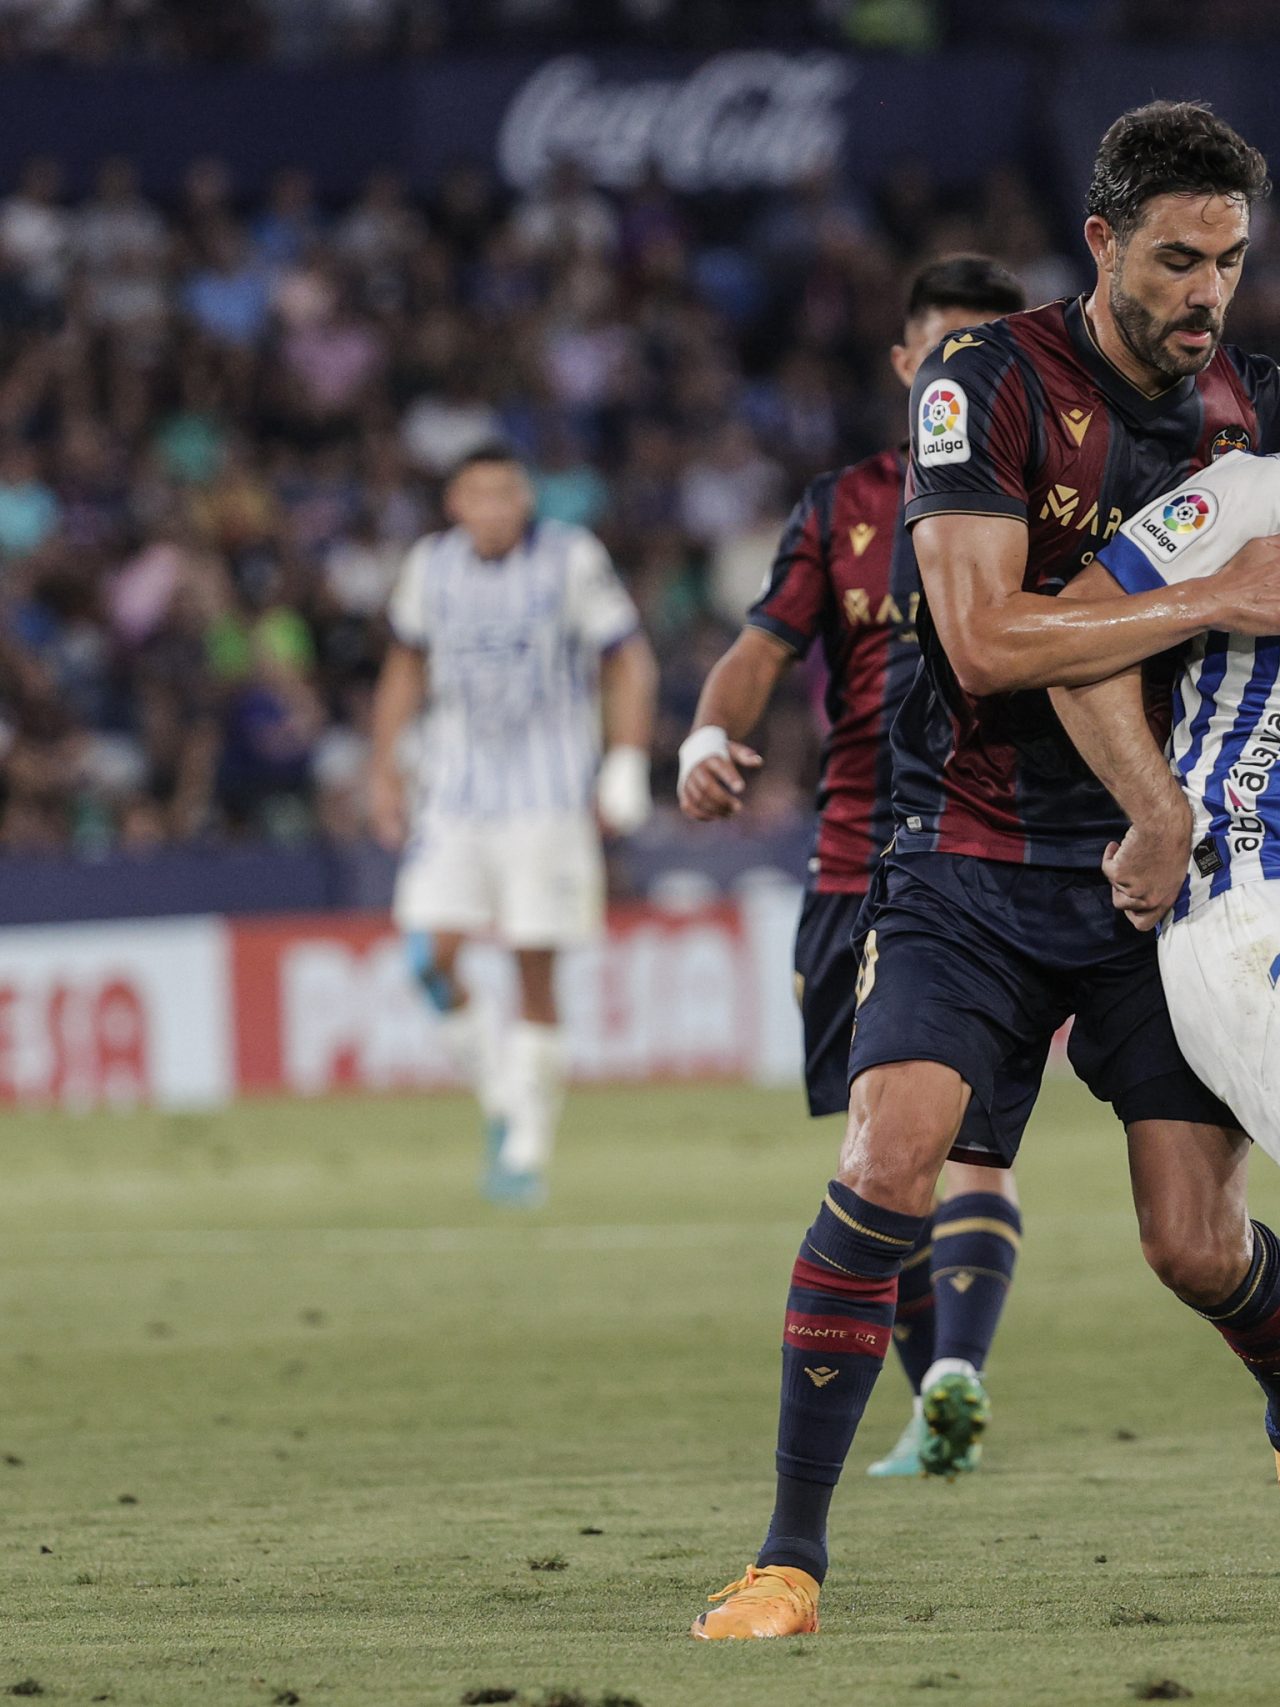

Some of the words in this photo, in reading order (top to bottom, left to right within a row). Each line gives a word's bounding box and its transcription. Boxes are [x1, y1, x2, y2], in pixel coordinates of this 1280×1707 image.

[923, 439, 964, 455] LaLiga
[1039, 484, 1123, 540] MAR
[1142, 518, 1178, 553] LaLiga
